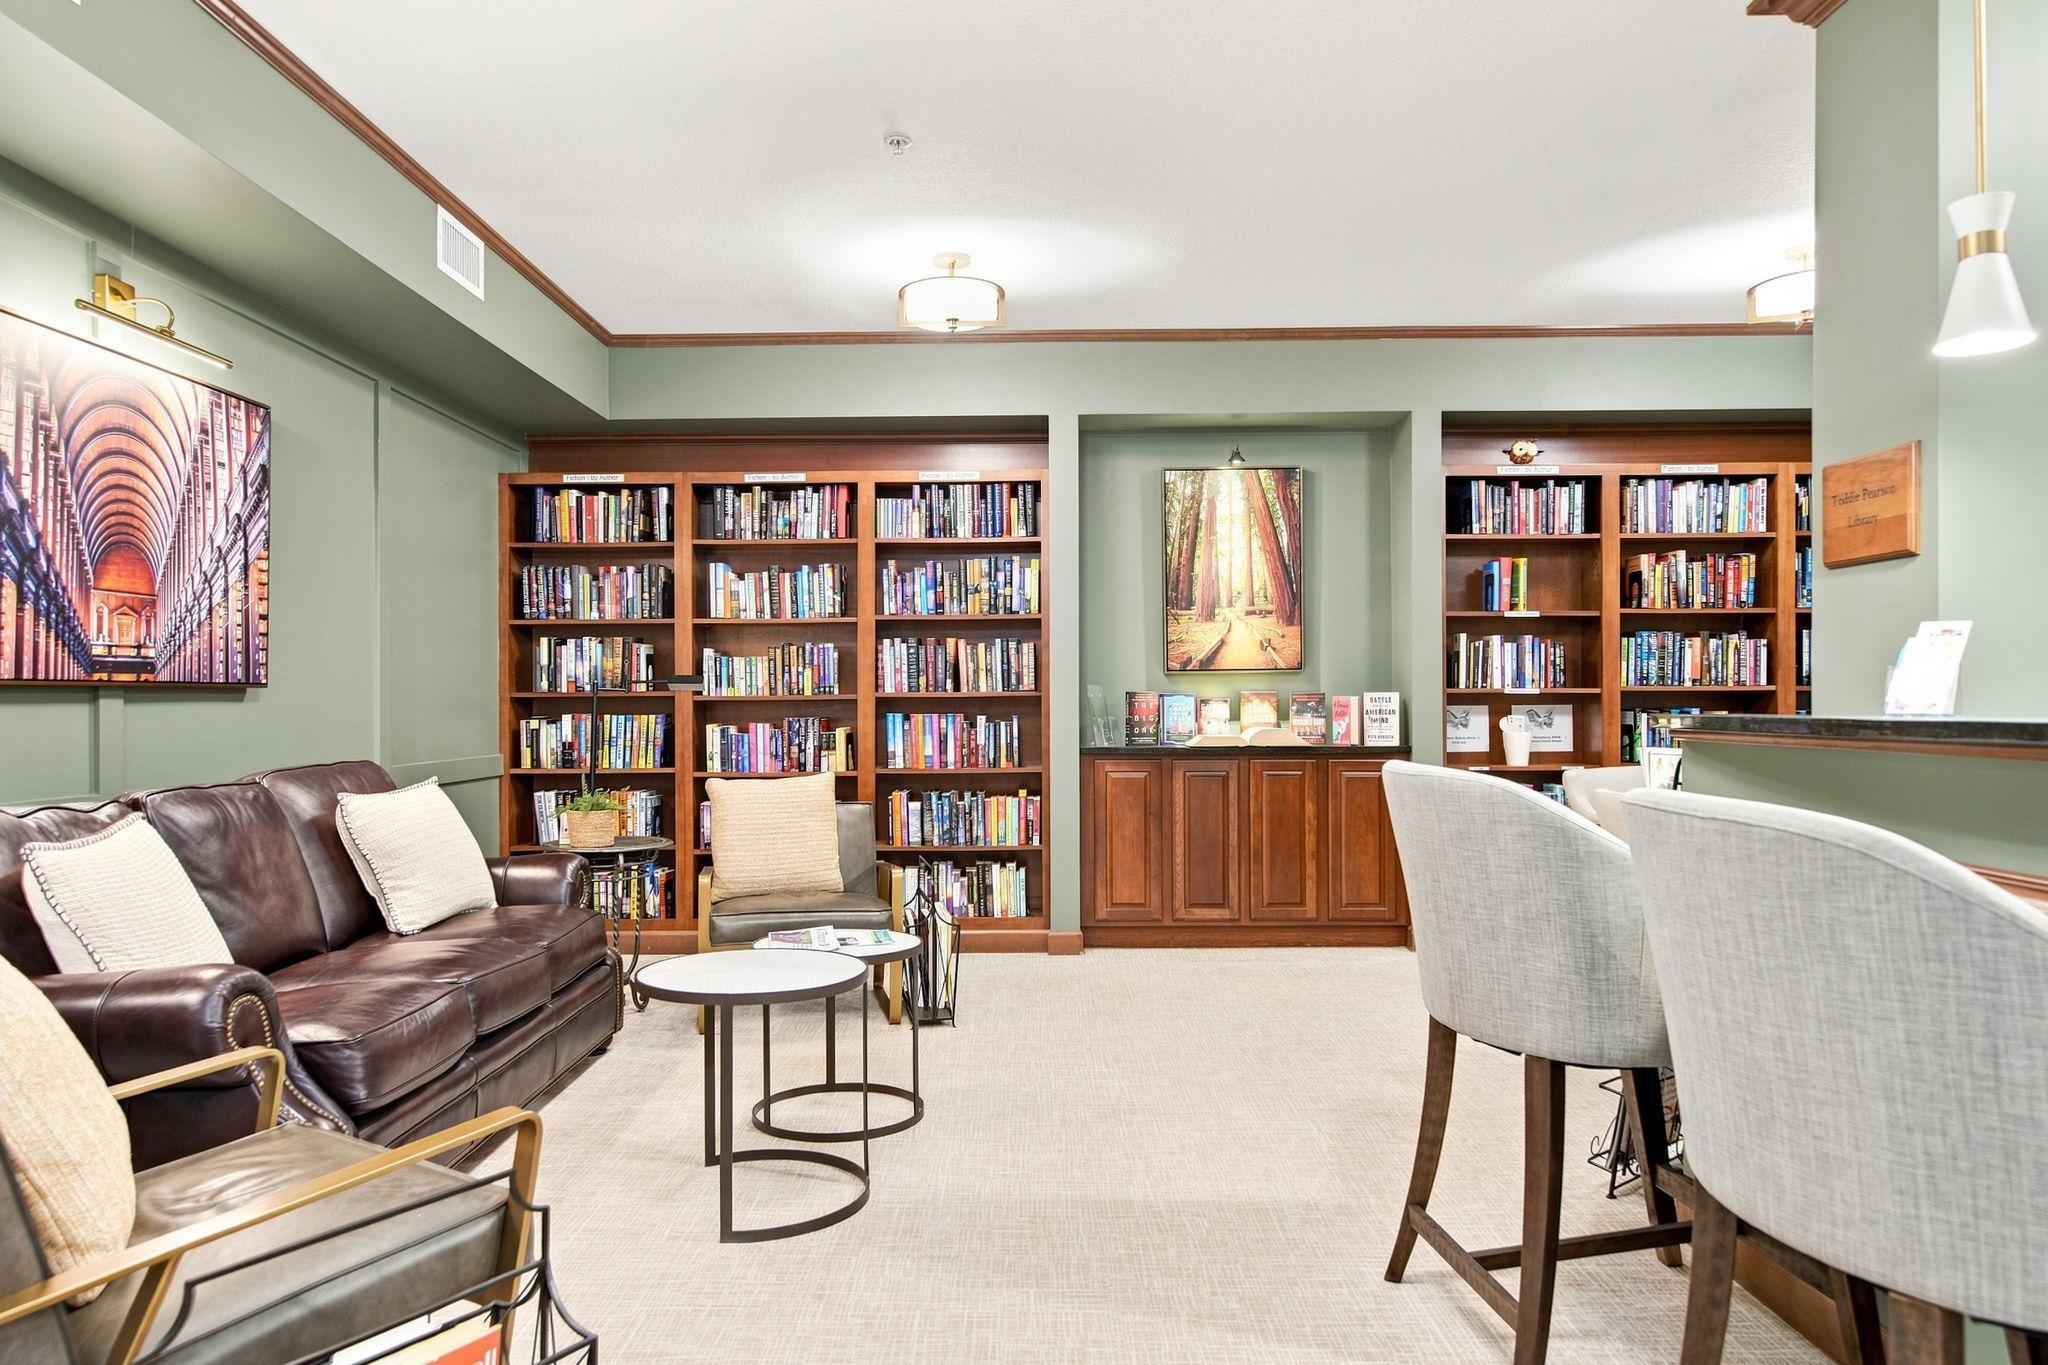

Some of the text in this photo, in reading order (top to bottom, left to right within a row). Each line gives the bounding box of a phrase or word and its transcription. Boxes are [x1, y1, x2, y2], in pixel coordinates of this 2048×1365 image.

[1861, 485, 1897, 501] Pearson
[1847, 514, 1879, 528] Library
[1369, 696, 1392, 704] BATTLE
[1134, 702, 1154, 710] THE
[1365, 708, 1397, 716] AMERICAN
[1134, 714, 1154, 722] BIG
